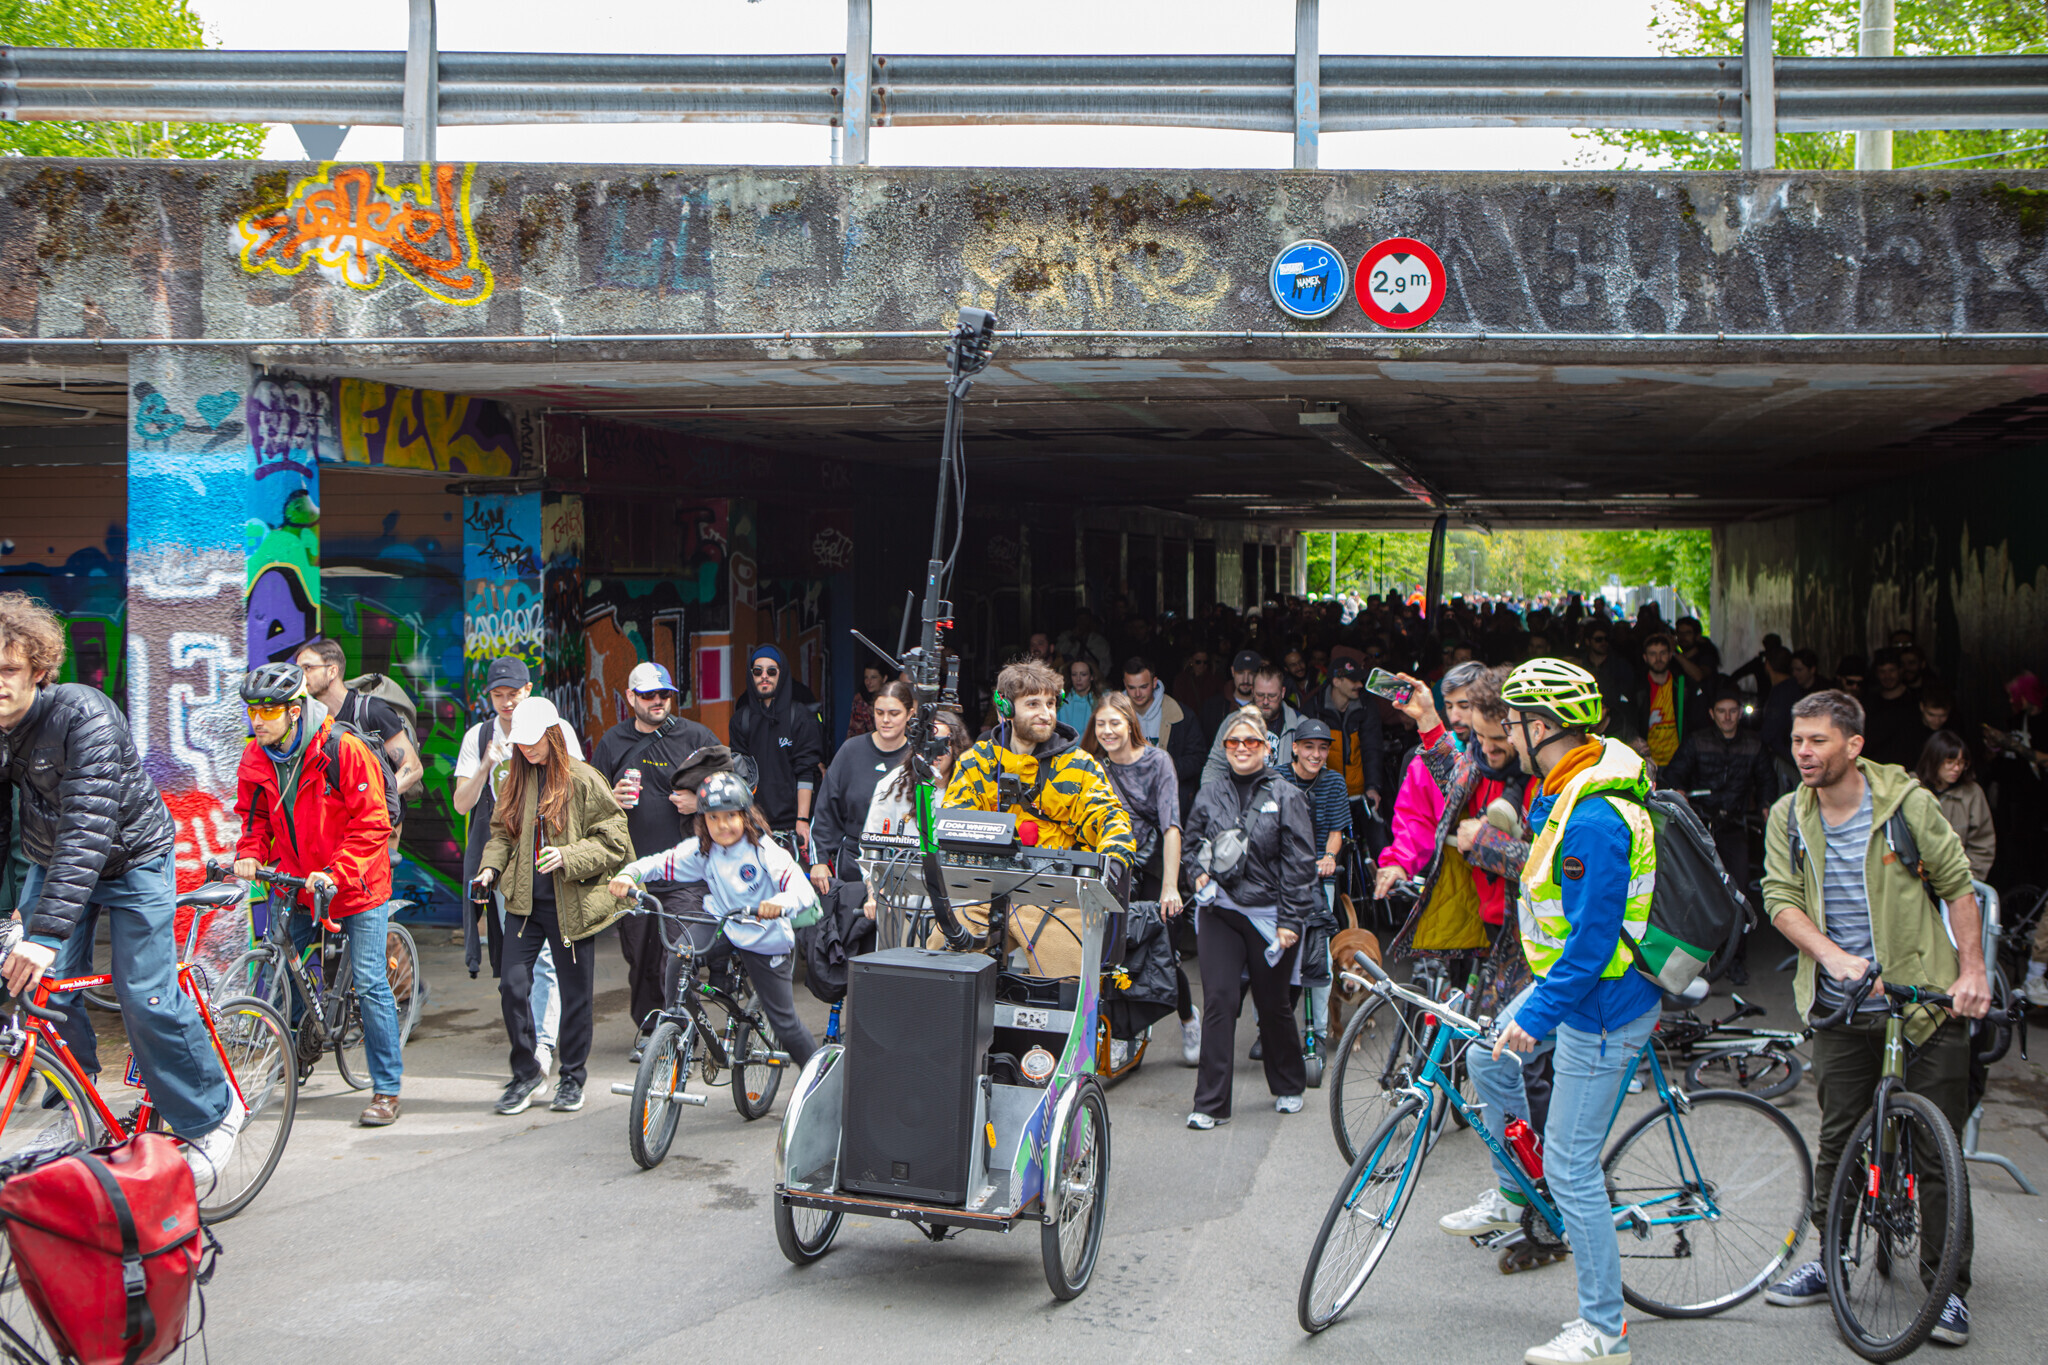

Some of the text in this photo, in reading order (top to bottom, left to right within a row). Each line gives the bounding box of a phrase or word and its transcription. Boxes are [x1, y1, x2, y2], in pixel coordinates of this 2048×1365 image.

[1410, 273, 1427, 287] m
[944, 822, 1003, 833] DOM WHITING
[861, 833, 921, 847] @domwhiting
